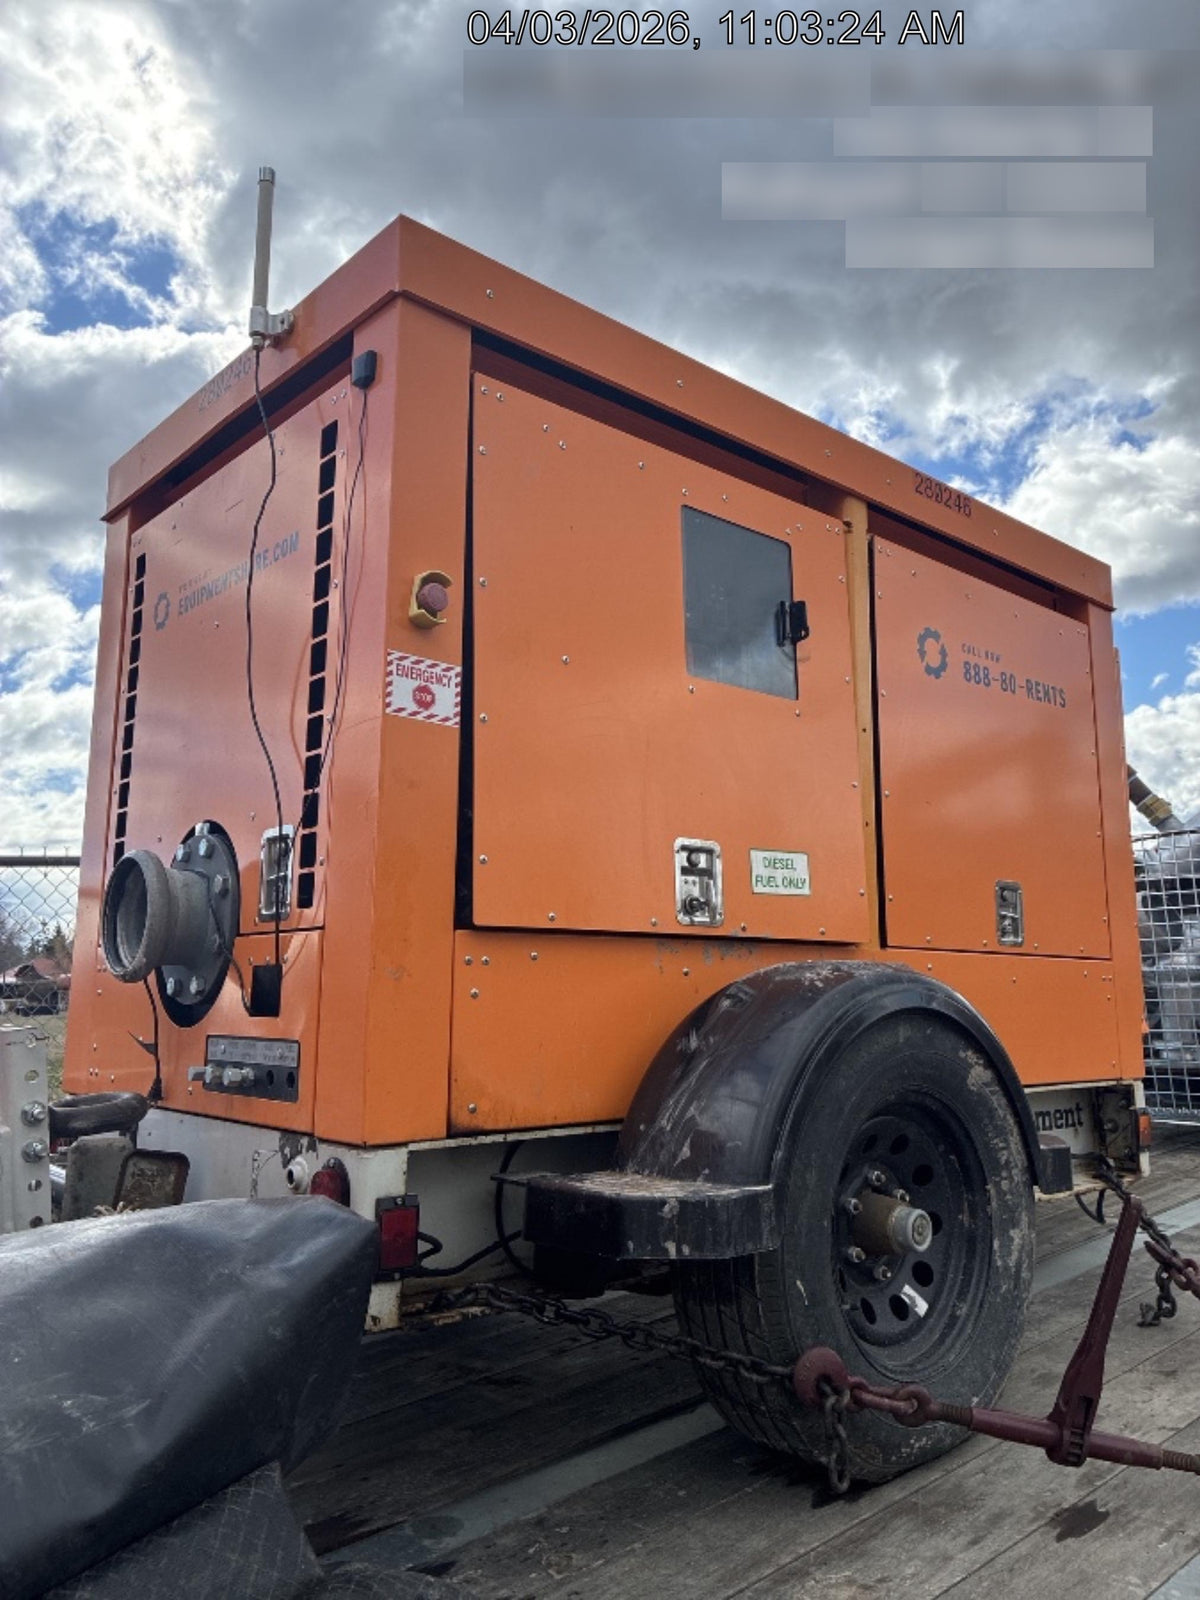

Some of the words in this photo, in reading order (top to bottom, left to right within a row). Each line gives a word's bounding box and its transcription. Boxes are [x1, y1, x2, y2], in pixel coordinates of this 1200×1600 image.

[914, 472, 972, 518] 280246
[177, 530, 300, 617] EQUIPMENTSHRE.COM
[395, 662, 453, 689] EMERGENCY
[963, 660, 1067, 709] 888-80-RENTS
[414, 690, 433, 704] STOP
[762, 856, 797, 871] DIESEL
[755, 874, 780, 888] FUEL
[782, 876, 807, 890] ONLY
